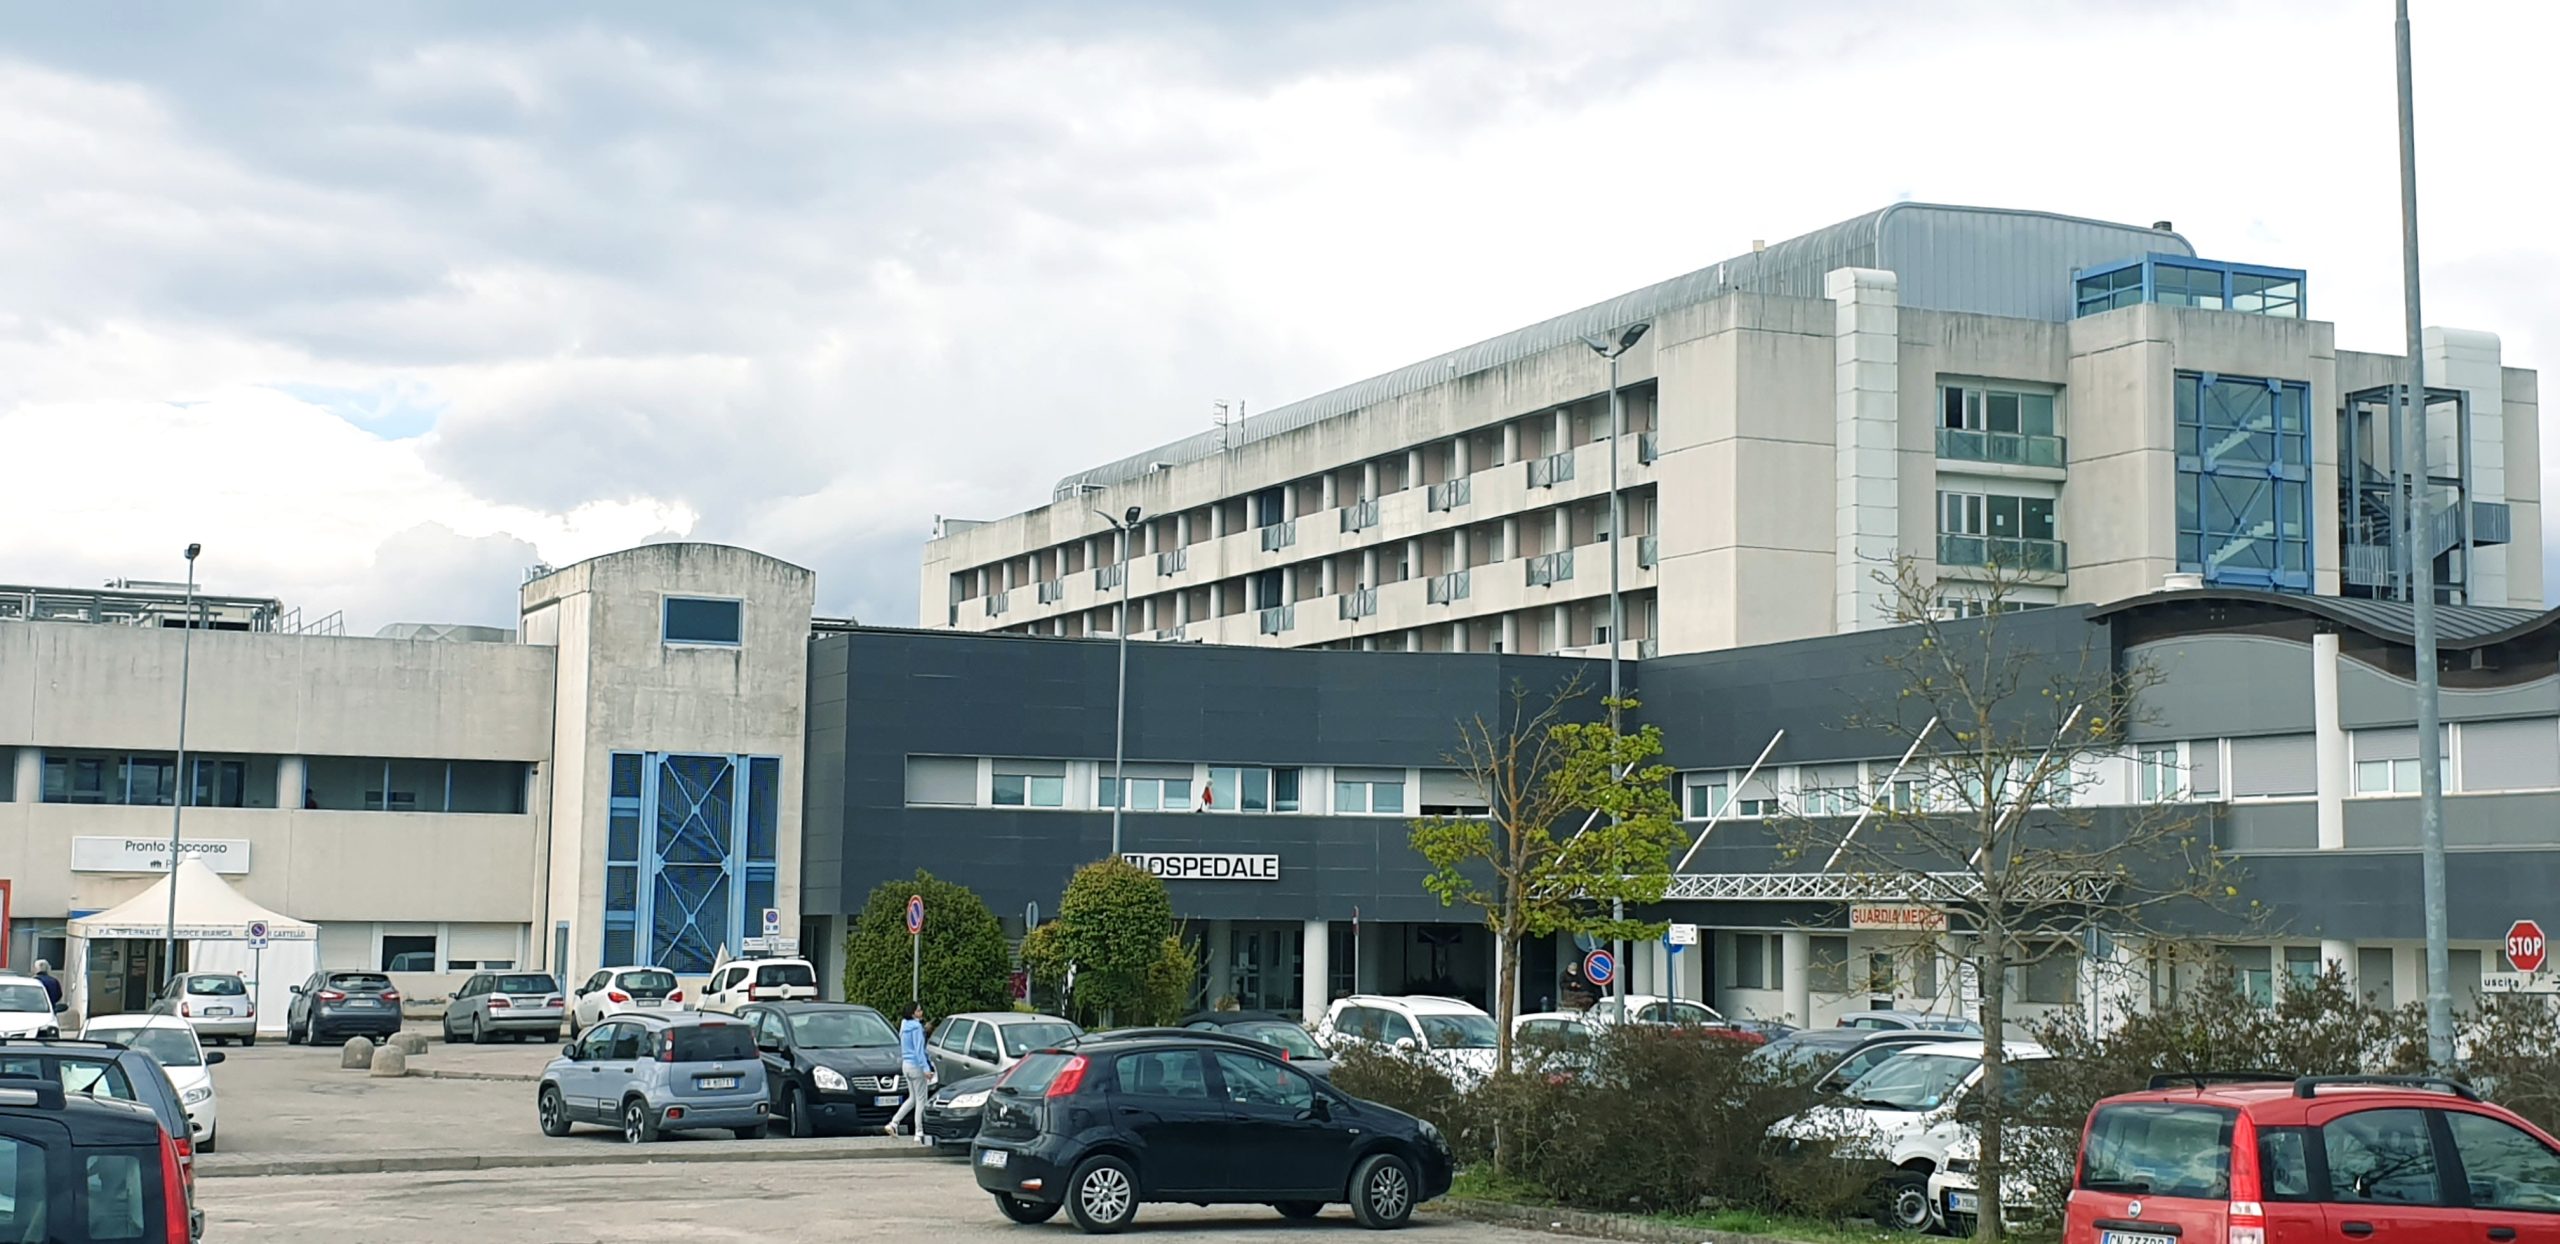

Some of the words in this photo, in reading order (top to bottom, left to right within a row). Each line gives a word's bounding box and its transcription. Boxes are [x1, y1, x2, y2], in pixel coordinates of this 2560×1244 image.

[125, 840, 166, 852] Pronto
[169, 841, 228, 853] Soccorso
[1148, 857, 1276, 877] OSPEDALE
[1851, 908, 1898, 923] GUARDIA
[1903, 909, 1944, 924] MEDCA
[2509, 937, 2542, 956] STOP
